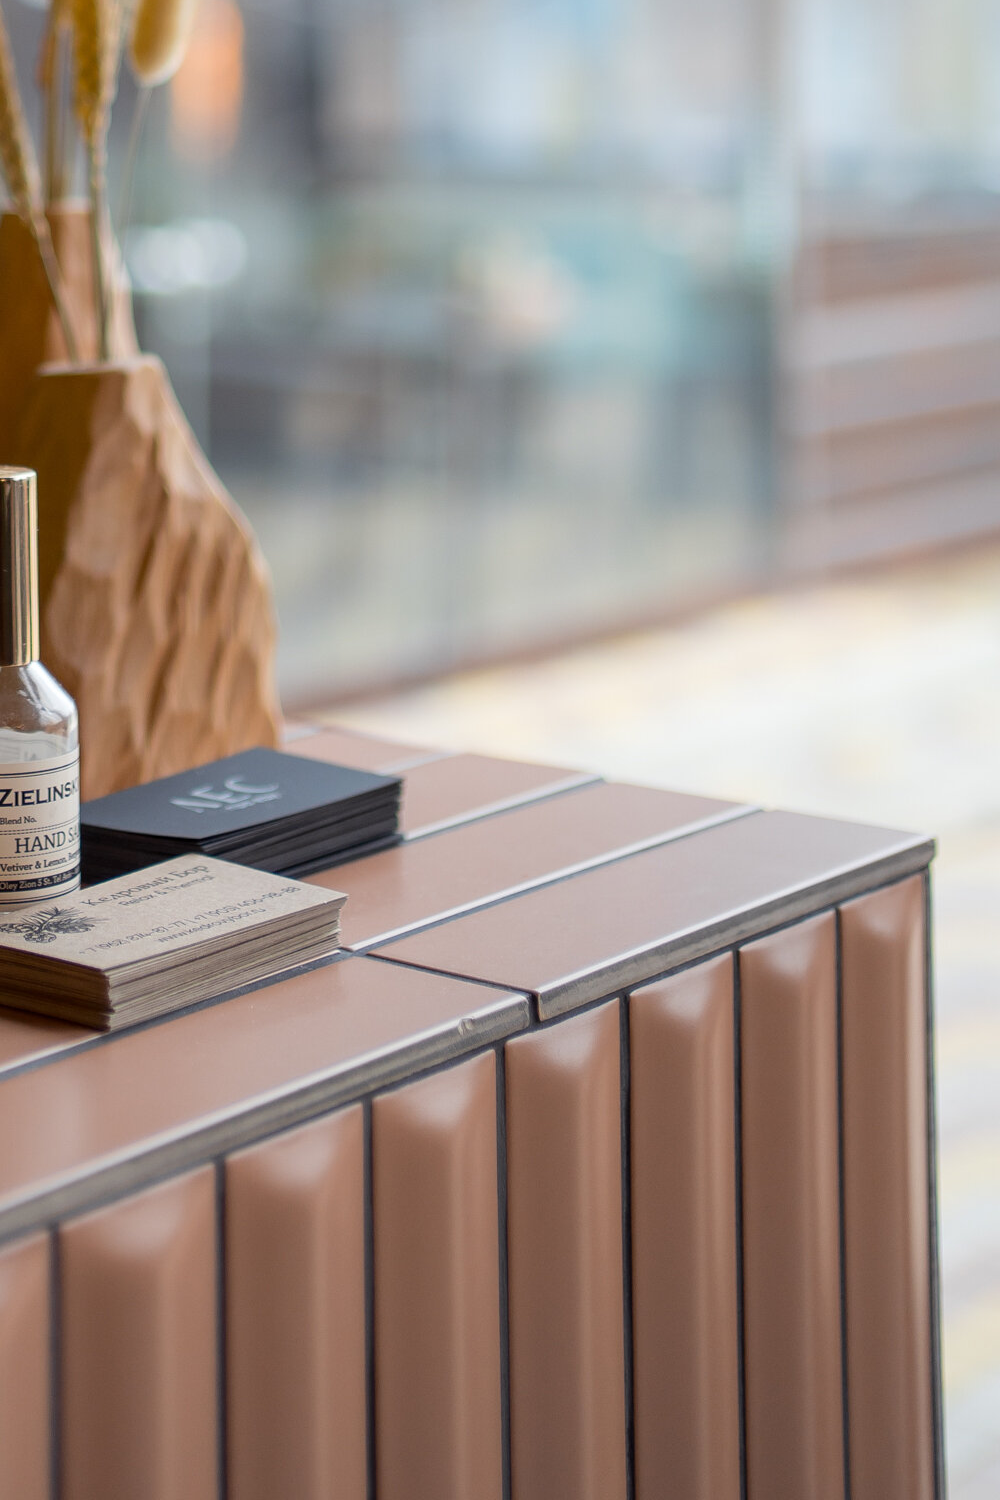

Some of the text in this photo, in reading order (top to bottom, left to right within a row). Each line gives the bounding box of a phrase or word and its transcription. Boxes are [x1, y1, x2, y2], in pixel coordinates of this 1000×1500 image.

[0, 815, 37, 825] Blend No.
[14, 831, 66, 854] HAND
[0, 863, 33, 872] Vetiver
[35, 860, 42, 870] &
[19, 879, 36, 889] Zion
[80, 865, 209, 906] Кедровый Бор
[118, 893, 155, 906] Relax
[164, 874, 215, 894] Thermal
